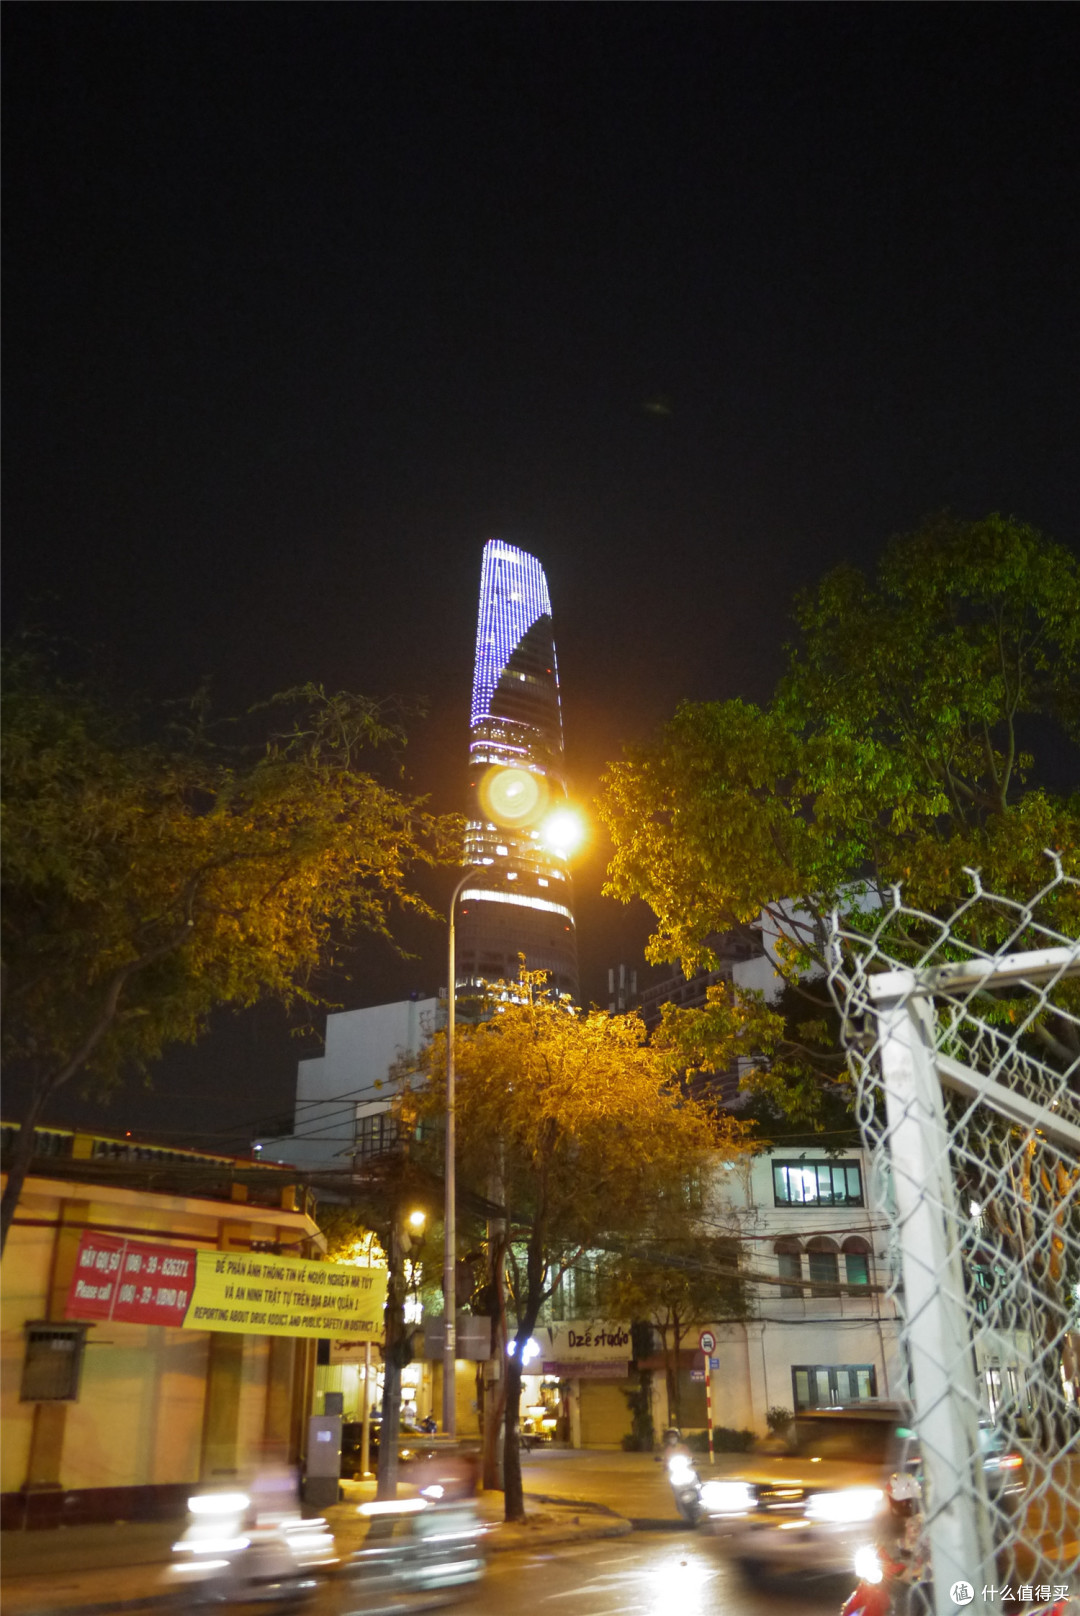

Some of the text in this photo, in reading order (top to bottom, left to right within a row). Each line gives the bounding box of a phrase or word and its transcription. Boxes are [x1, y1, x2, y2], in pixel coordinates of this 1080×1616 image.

[194, 1306, 229, 1321] REPORTING
[230, 1310, 249, 1323] ABOUT
[250, 1312, 267, 1325] DRUG
[268, 1313, 288, 1326] ADDICT
[289, 1315, 301, 1327] AND
[302, 1315, 322, 1329] PUBLIC
[323, 1317, 343, 1330] SAFETY
[350, 1320, 374, 1332] DISTRICT
